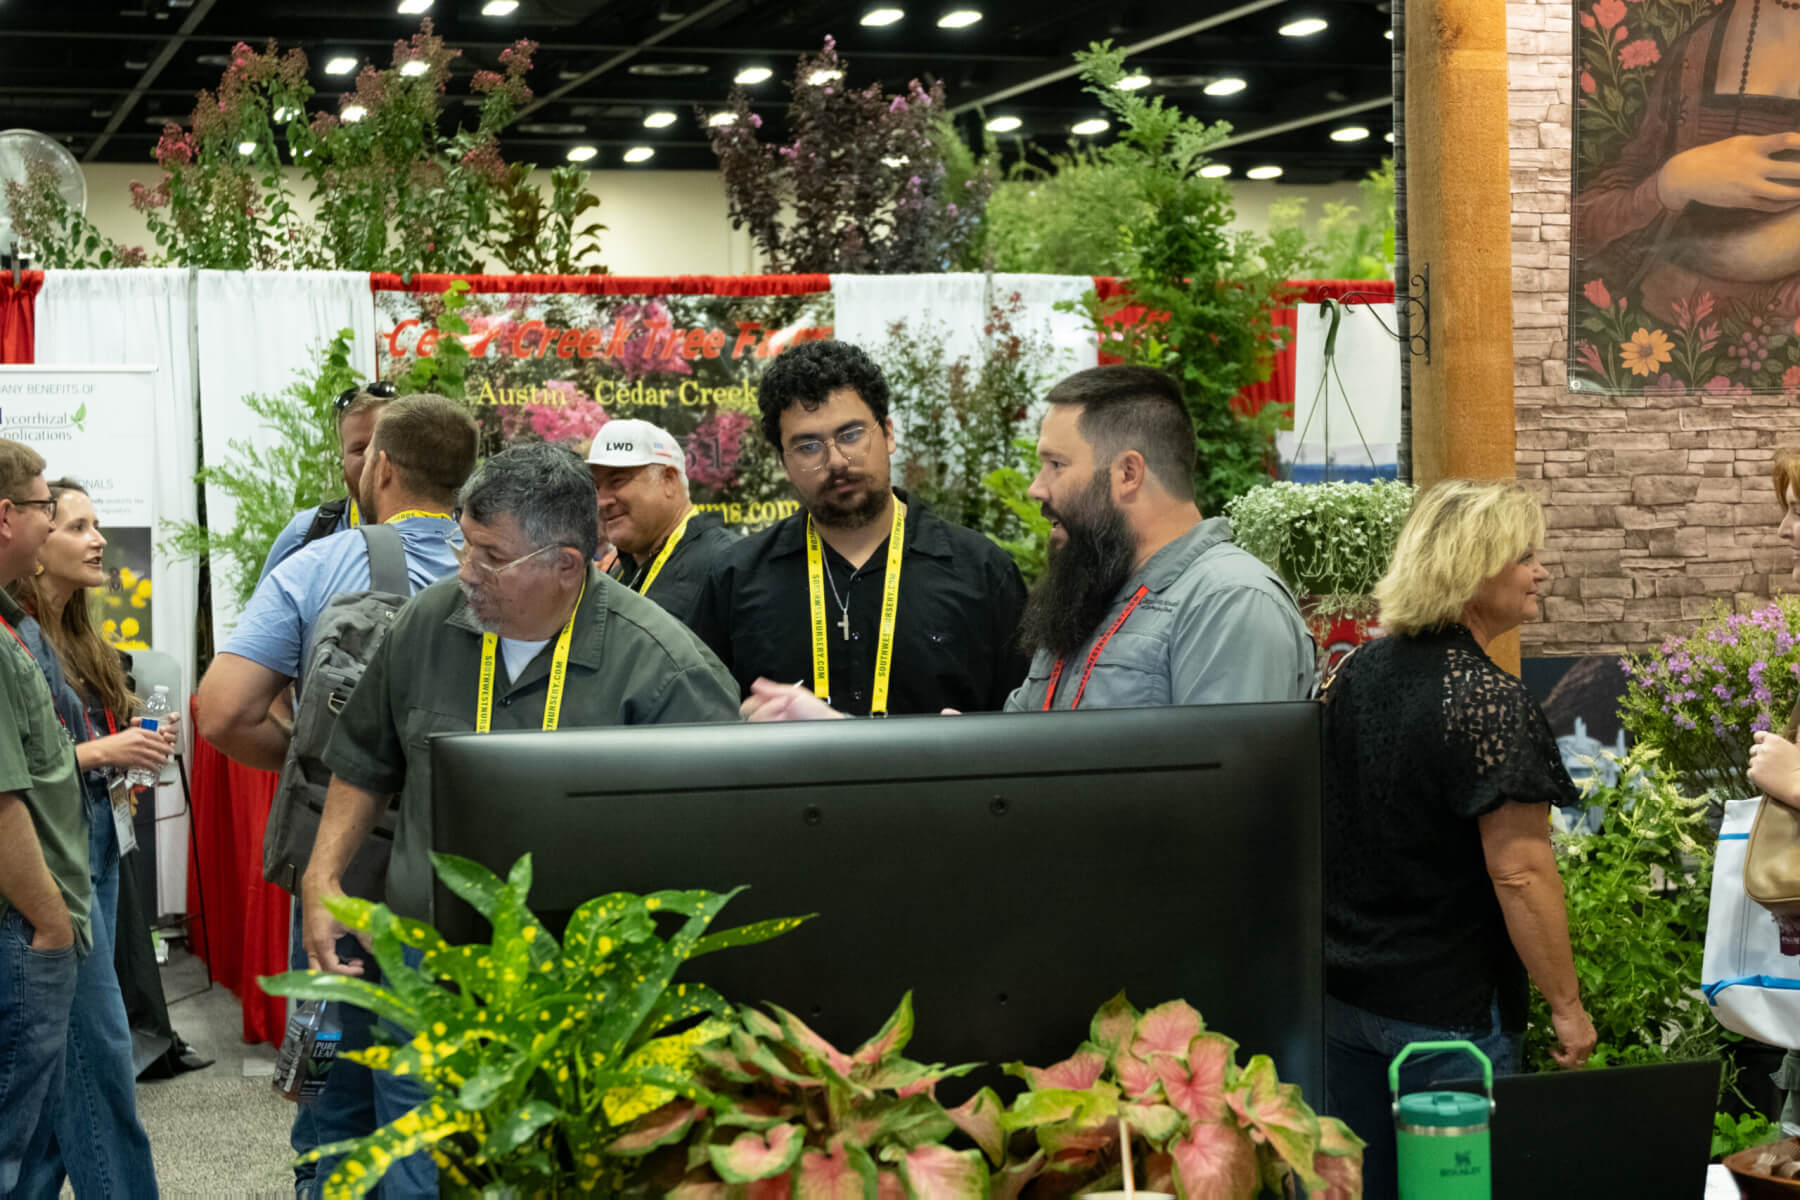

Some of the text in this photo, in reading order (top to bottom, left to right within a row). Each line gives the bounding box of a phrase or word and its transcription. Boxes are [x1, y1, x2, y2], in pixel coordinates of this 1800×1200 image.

[511, 317, 633, 359] Creek
[643, 319, 726, 360] Tree
[0, 384, 96, 395] ANY BENEFITS OF
[477, 380, 568, 406] Austin
[594, 380, 671, 407] Cedar
[679, 379, 759, 407] Creek
[0, 409, 67, 426] ycorrhizal
[605, 442, 634, 452] LWD
[812, 574, 826, 680] SOWNURSERY.COM
[877, 573, 898, 678] SOUTHWESURSERY.COM
